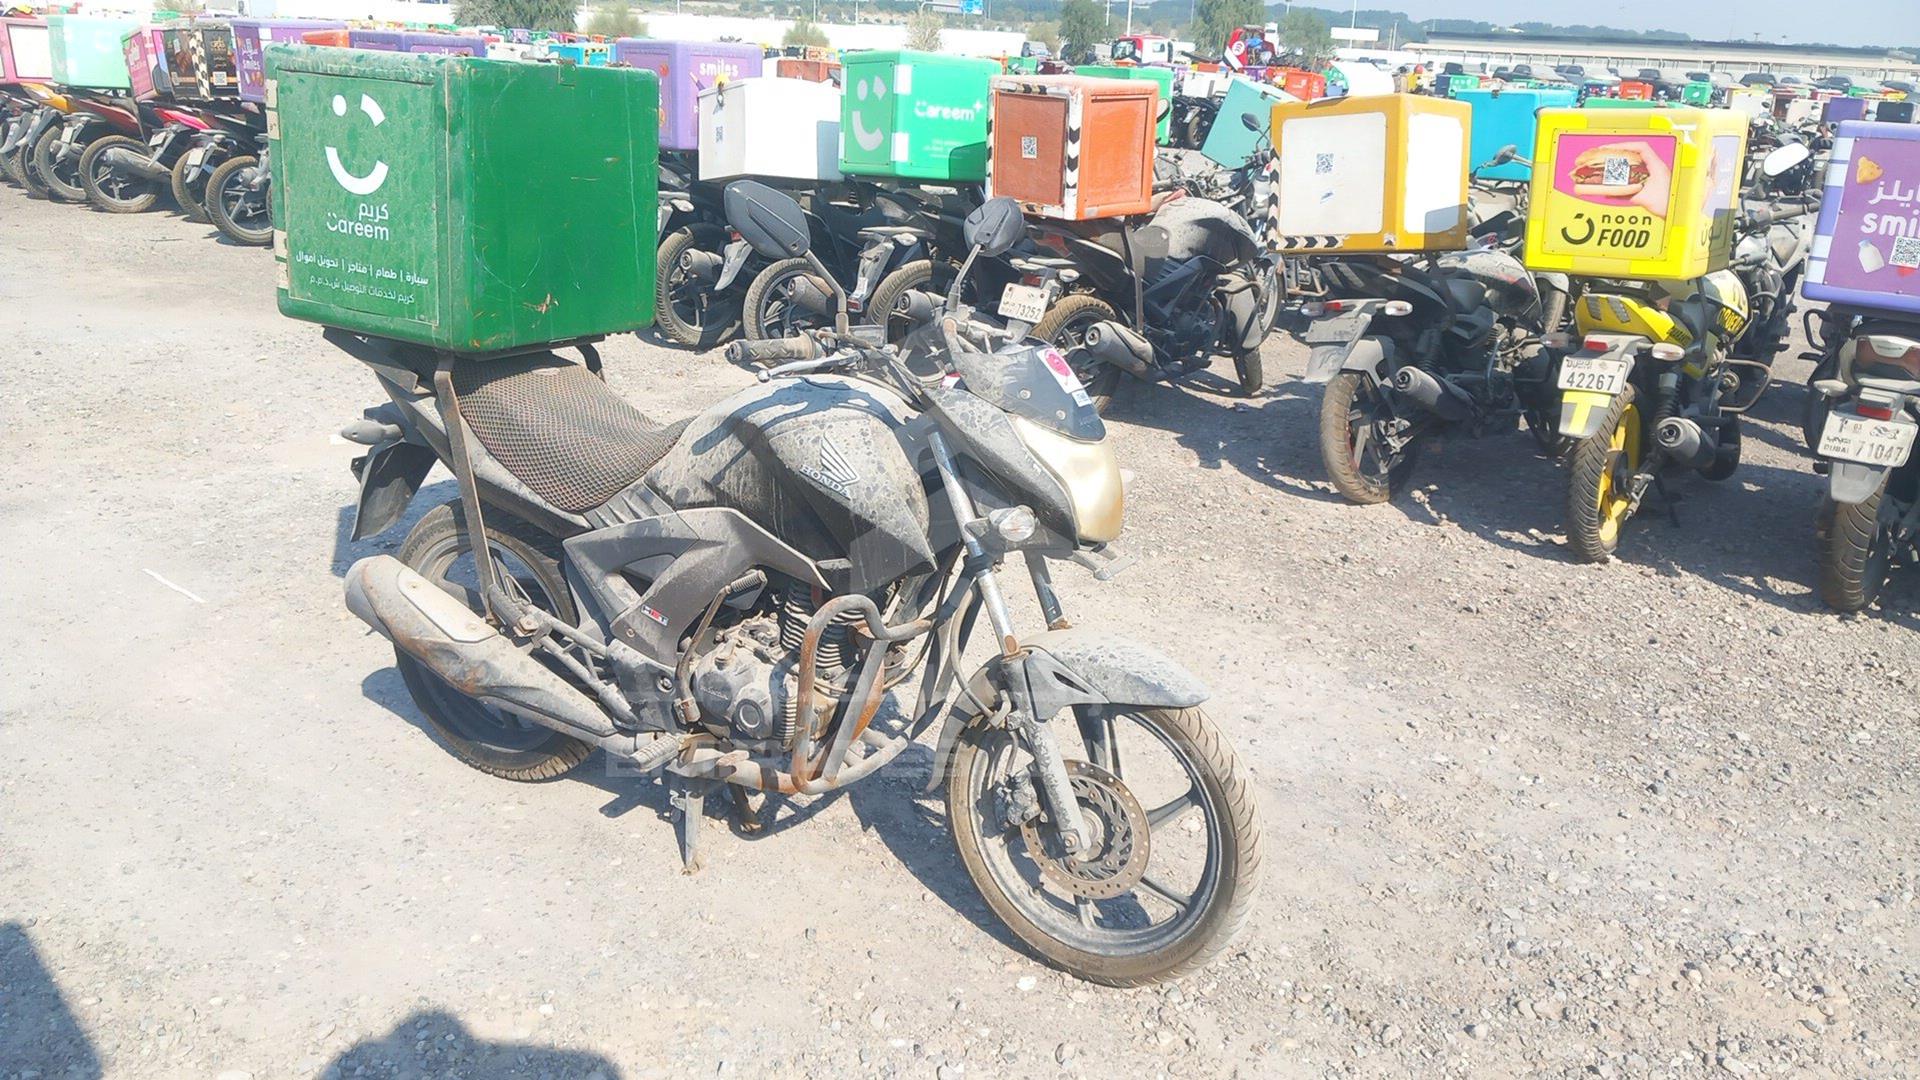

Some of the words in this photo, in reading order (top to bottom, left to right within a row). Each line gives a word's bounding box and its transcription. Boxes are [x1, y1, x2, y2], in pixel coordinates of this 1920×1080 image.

[700, 60, 739, 77] smiles
[358, 203, 389, 223] كريم
[1601, 213, 1652, 226] noon
[326, 212, 390, 241] Careem
[1597, 229, 1651, 249] FOOD
[375, 266, 398, 280] طعام
[1565, 371, 1616, 391] 42267
[1855, 439, 1905, 463] 71047
[798, 464, 851, 498] HONDA
